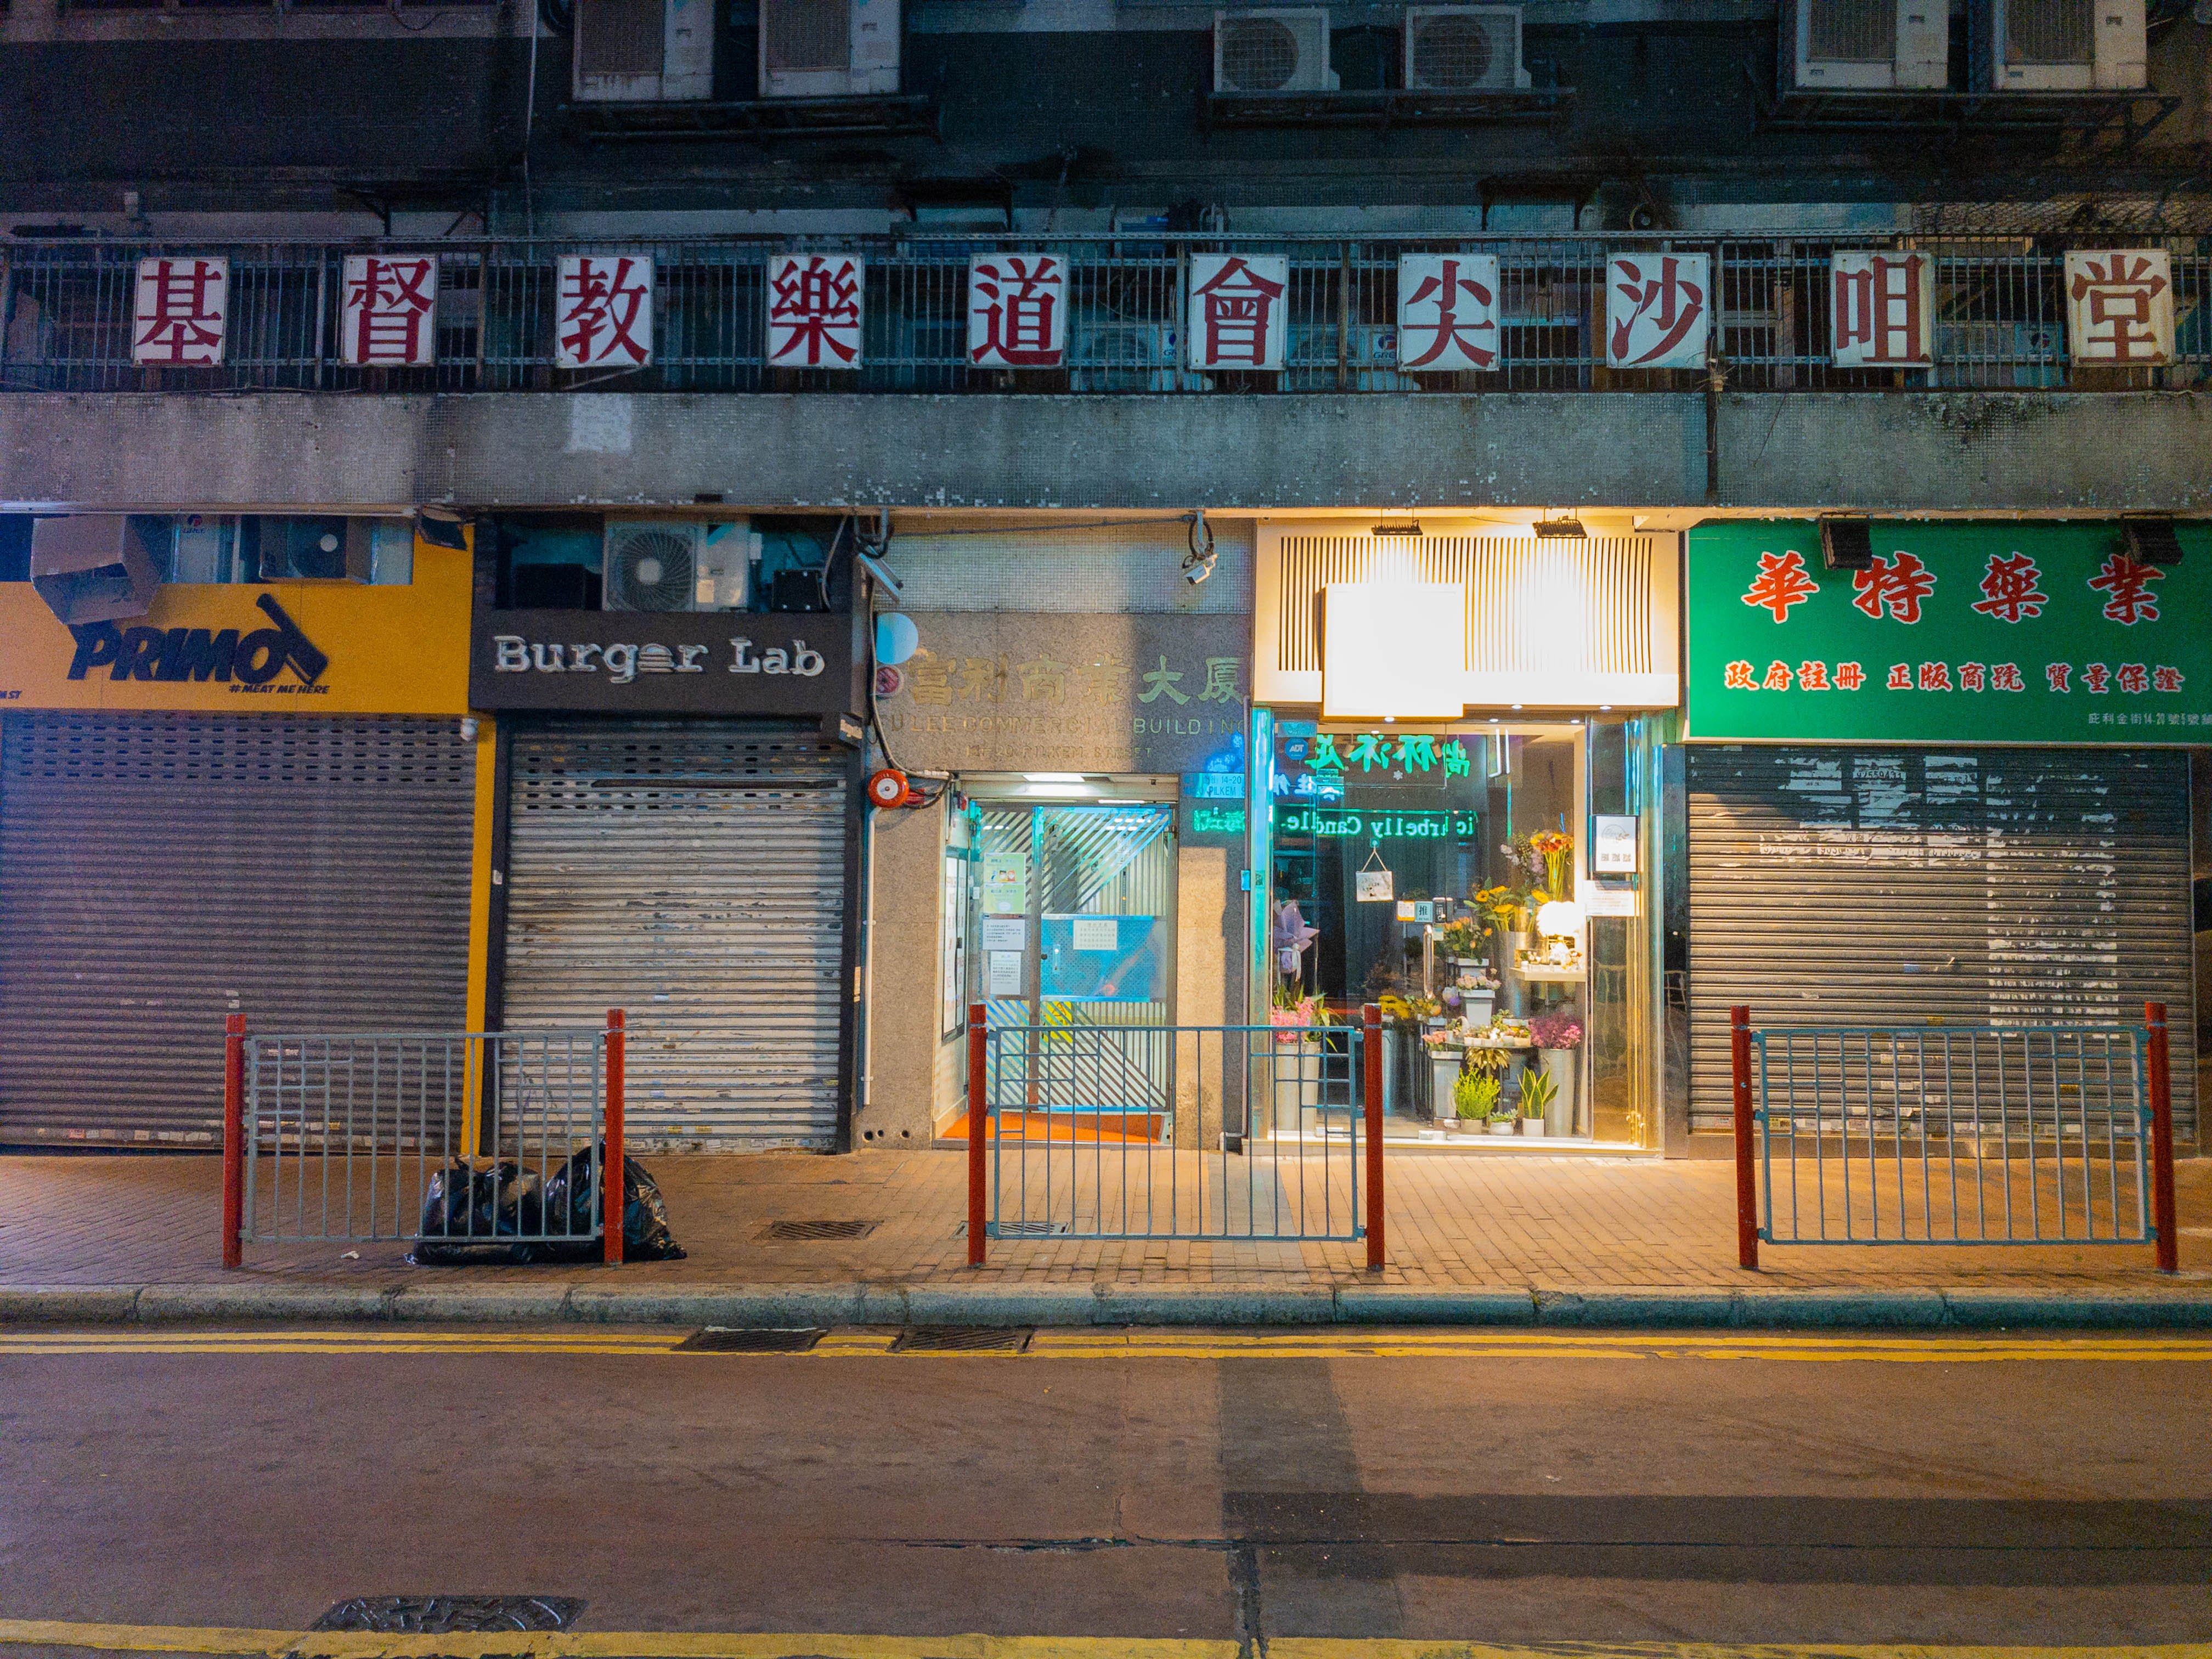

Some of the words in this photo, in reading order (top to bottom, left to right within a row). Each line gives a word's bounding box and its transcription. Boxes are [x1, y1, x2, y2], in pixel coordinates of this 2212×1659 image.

[67, 619, 285, 685] PRIMO
[493, 636, 709, 683] Burger
[728, 636, 826, 677] Lab
[276, 685, 296, 693] ME
[297, 685, 330, 695] HERE
[1724, 660, 1867, 691] 政府註冊
[1886, 661, 2025, 693] 正版商號
[2045, 662, 2185, 694] 質量保證
[911, 715, 955, 732] LEE
[963, 716, 1125, 735] COMMERCIAL
[1021, 746, 1085, 758] PILKEM
[1093, 746, 1153, 759] STREET
